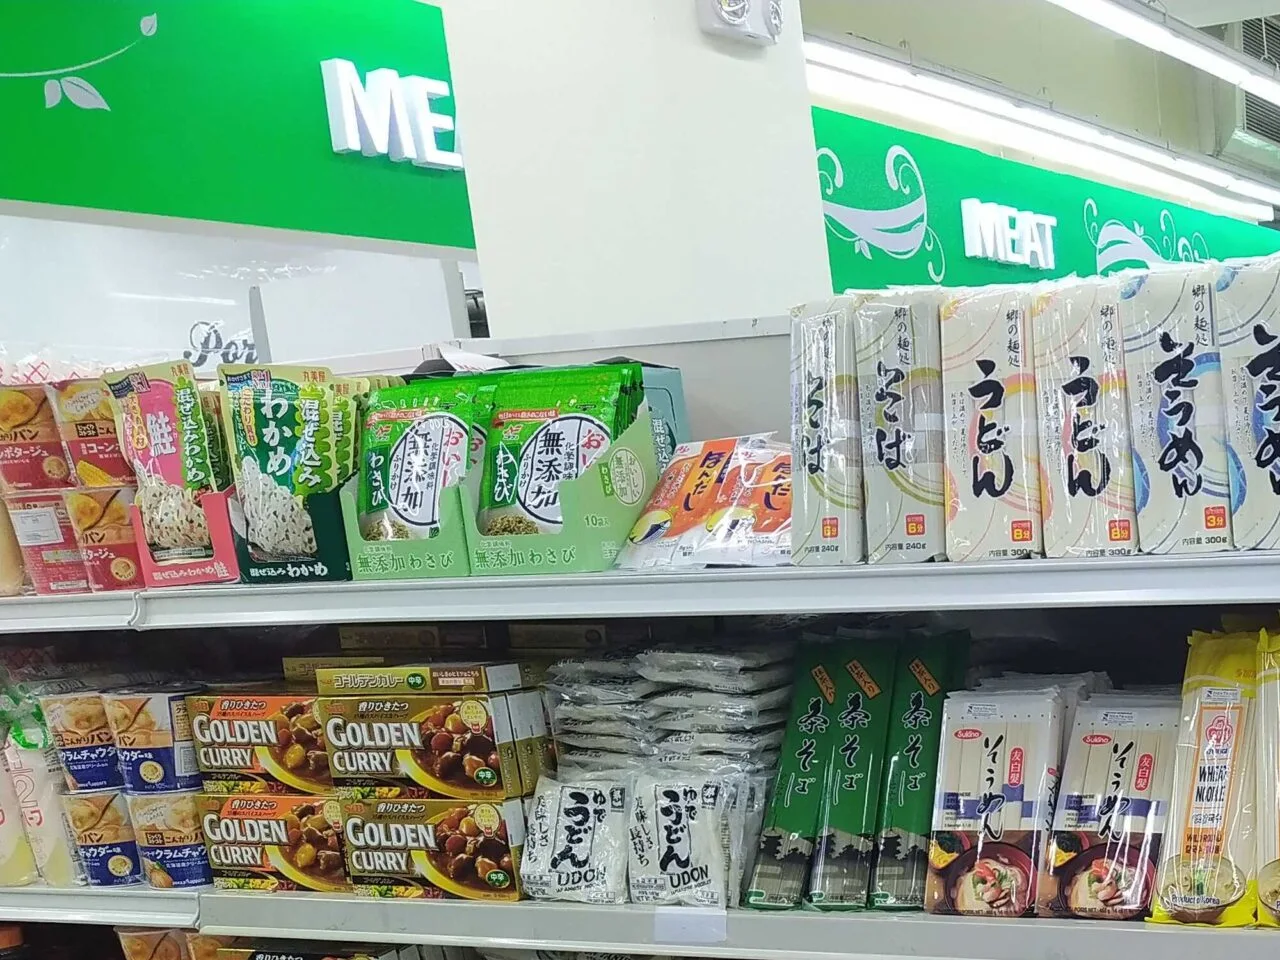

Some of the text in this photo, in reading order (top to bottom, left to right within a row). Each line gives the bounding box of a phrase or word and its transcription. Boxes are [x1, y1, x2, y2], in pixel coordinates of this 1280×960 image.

[320, 57, 465, 171] ME
[961, 198, 1058, 270] MEAT
[260, 390, 293, 476] わかめ
[968, 359, 1014, 498] うどん
[194, 716, 278, 746] GOLDEN
[327, 717, 424, 749] GOLDEN
[200, 747, 254, 773] CURRY
[332, 751, 393, 774] CURRY
[204, 817, 290, 846] GOLDEN
[346, 821, 439, 850] GOLDEN
[209, 846, 266, 867] CURRY
[350, 849, 409, 873] CURRY
[670, 863, 709, 890] UDON
